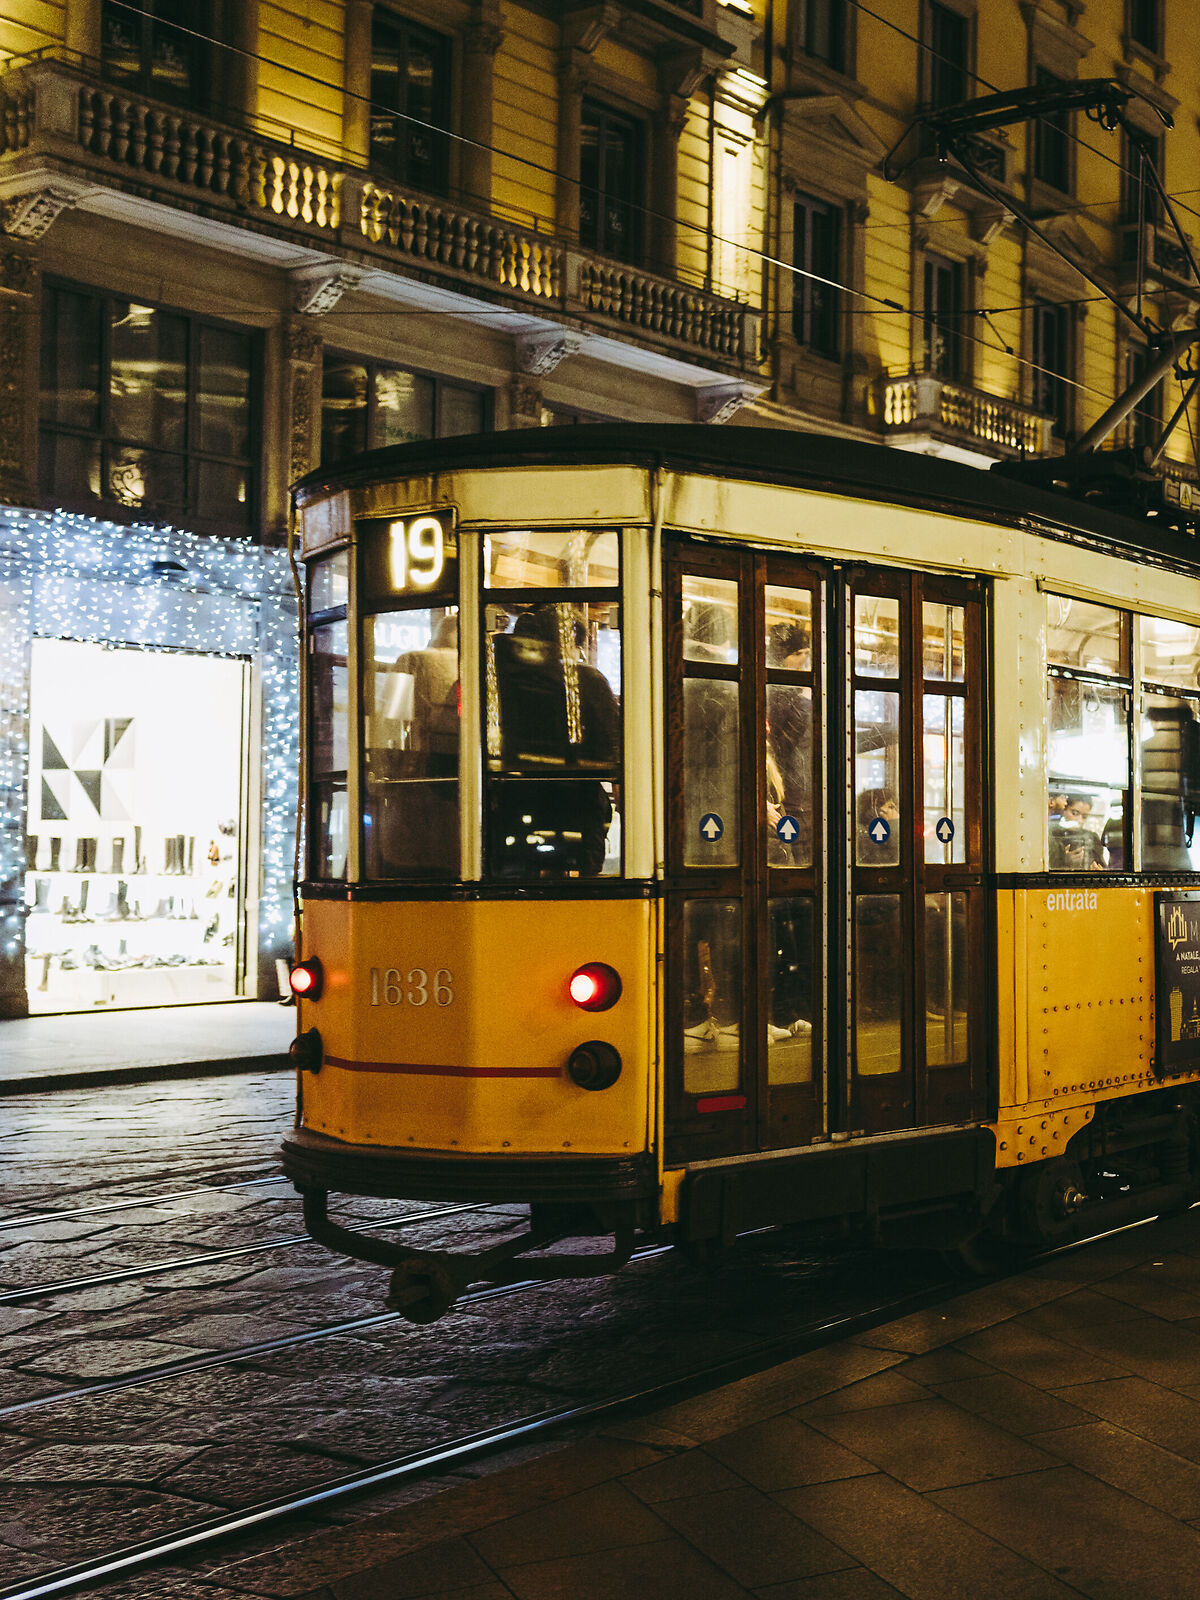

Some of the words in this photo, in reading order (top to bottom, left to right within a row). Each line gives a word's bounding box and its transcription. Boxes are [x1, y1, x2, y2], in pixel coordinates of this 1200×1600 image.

[389, 516, 444, 588] 19
[1047, 889, 1097, 911] entrata
[370, 967, 454, 1006] 1636
